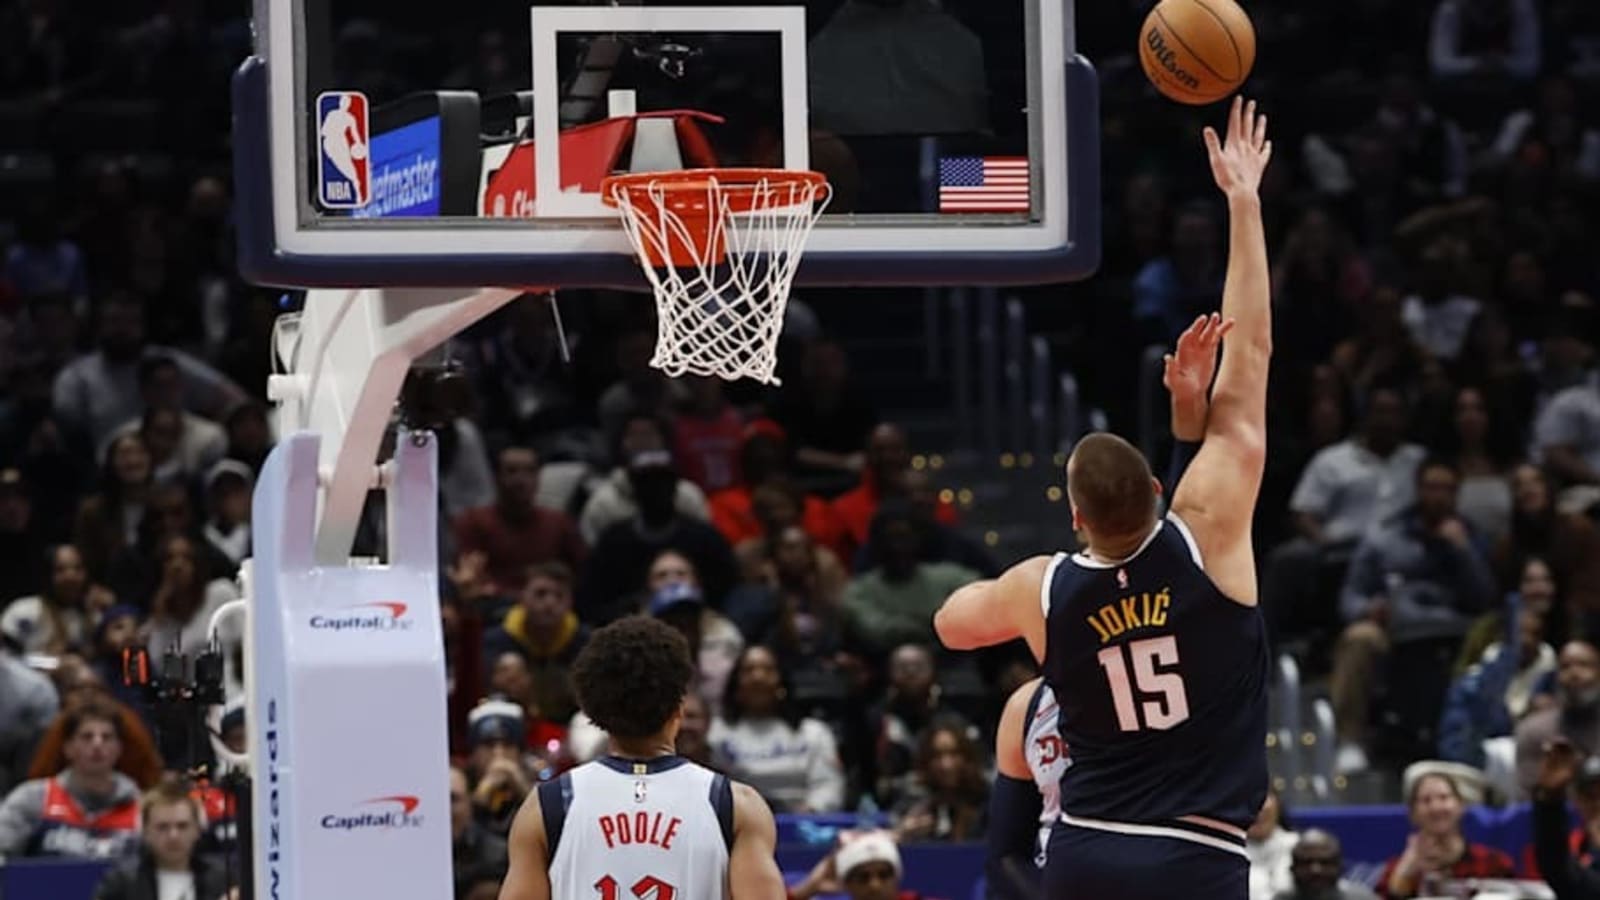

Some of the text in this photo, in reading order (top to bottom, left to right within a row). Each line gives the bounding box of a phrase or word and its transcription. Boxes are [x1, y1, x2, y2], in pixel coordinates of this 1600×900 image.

[1147, 27, 1199, 89] Wilson
[326, 181, 352, 201] NBA
[1087, 587, 1170, 643] JOKIĆ
[1097, 635, 1189, 732] 15
[599, 811, 682, 849] POOLE
